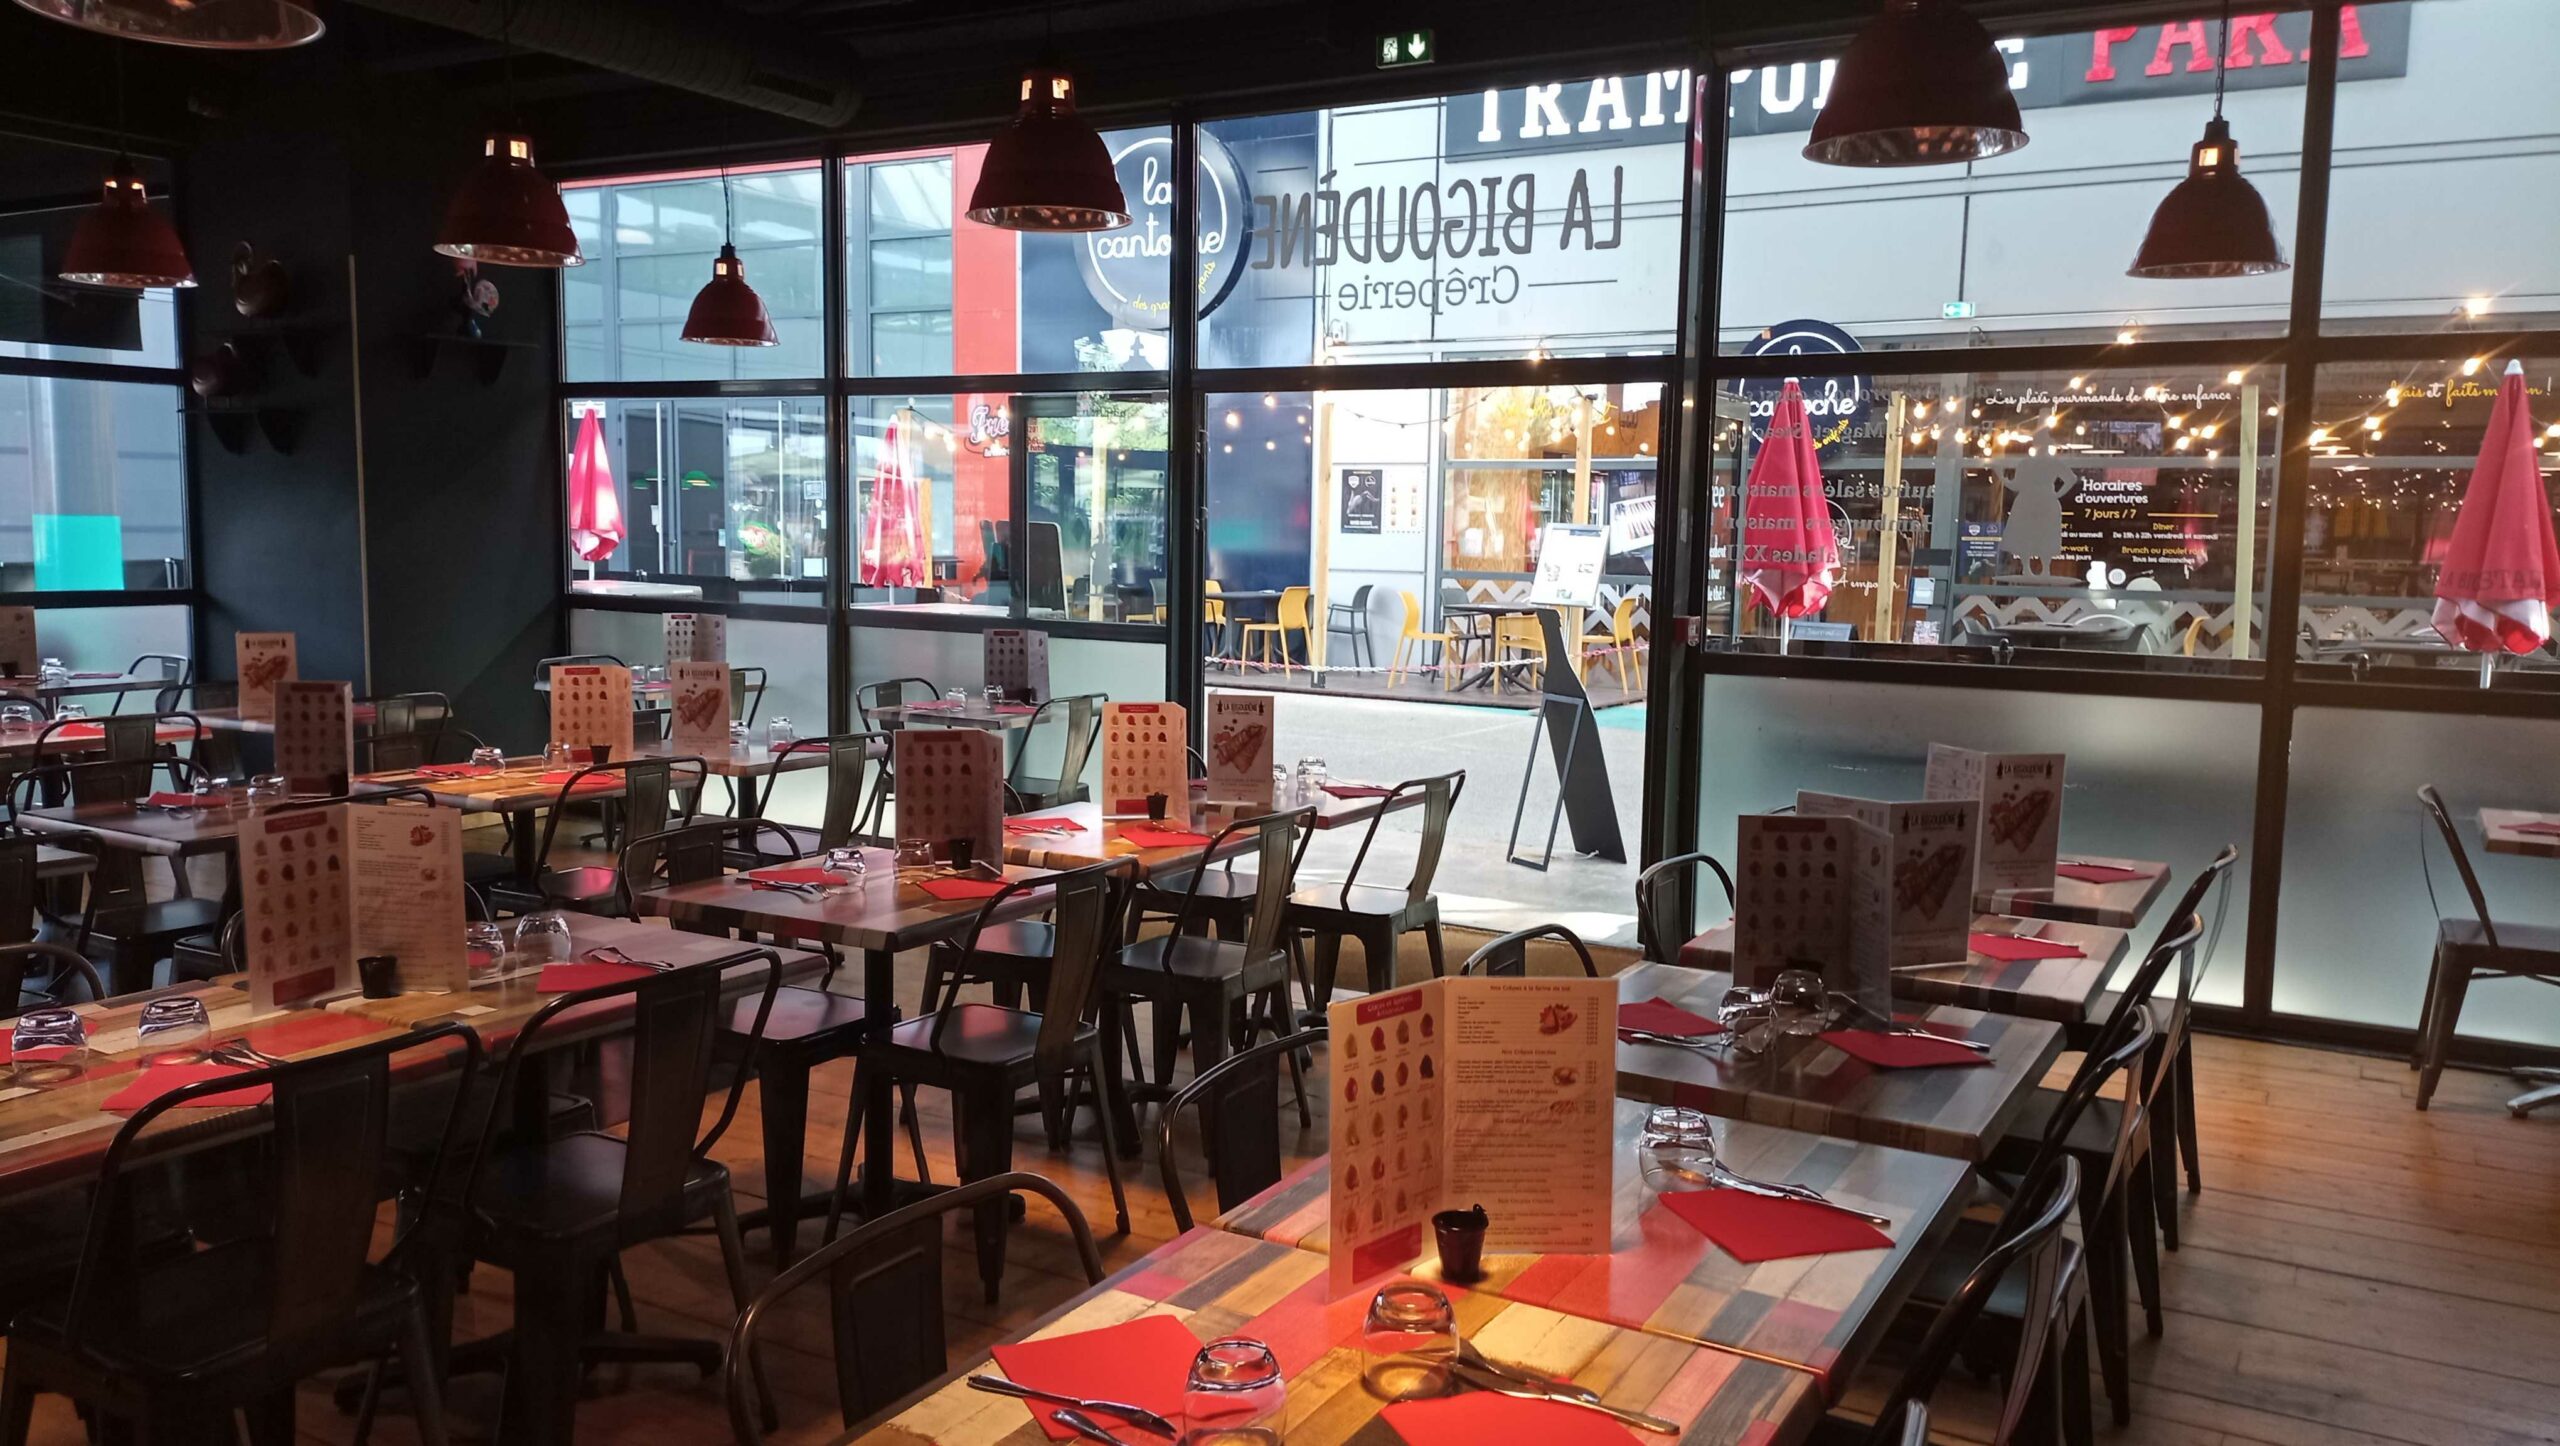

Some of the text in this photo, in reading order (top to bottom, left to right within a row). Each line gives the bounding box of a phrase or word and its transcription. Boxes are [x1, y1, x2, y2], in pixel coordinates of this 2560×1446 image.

[1097, 212, 1222, 259] cantoe
[1986, 388, 2016, 405] Les
[2052, 387, 2123, 412] gourmands
[2125, 387, 2142, 403] de
[2182, 384, 2231, 409] enfance
[2426, 382, 2445, 398] et
[2446, 379, 2482, 407] faits
[2082, 479, 2142, 492] Horaires
[2075, 493, 2148, 505] d'ouvertures
[2084, 508, 2091, 518] 7
[2092, 508, 2120, 521] jours
[2130, 508, 2137, 518] 7
[2122, 545, 2149, 555] Brunch
